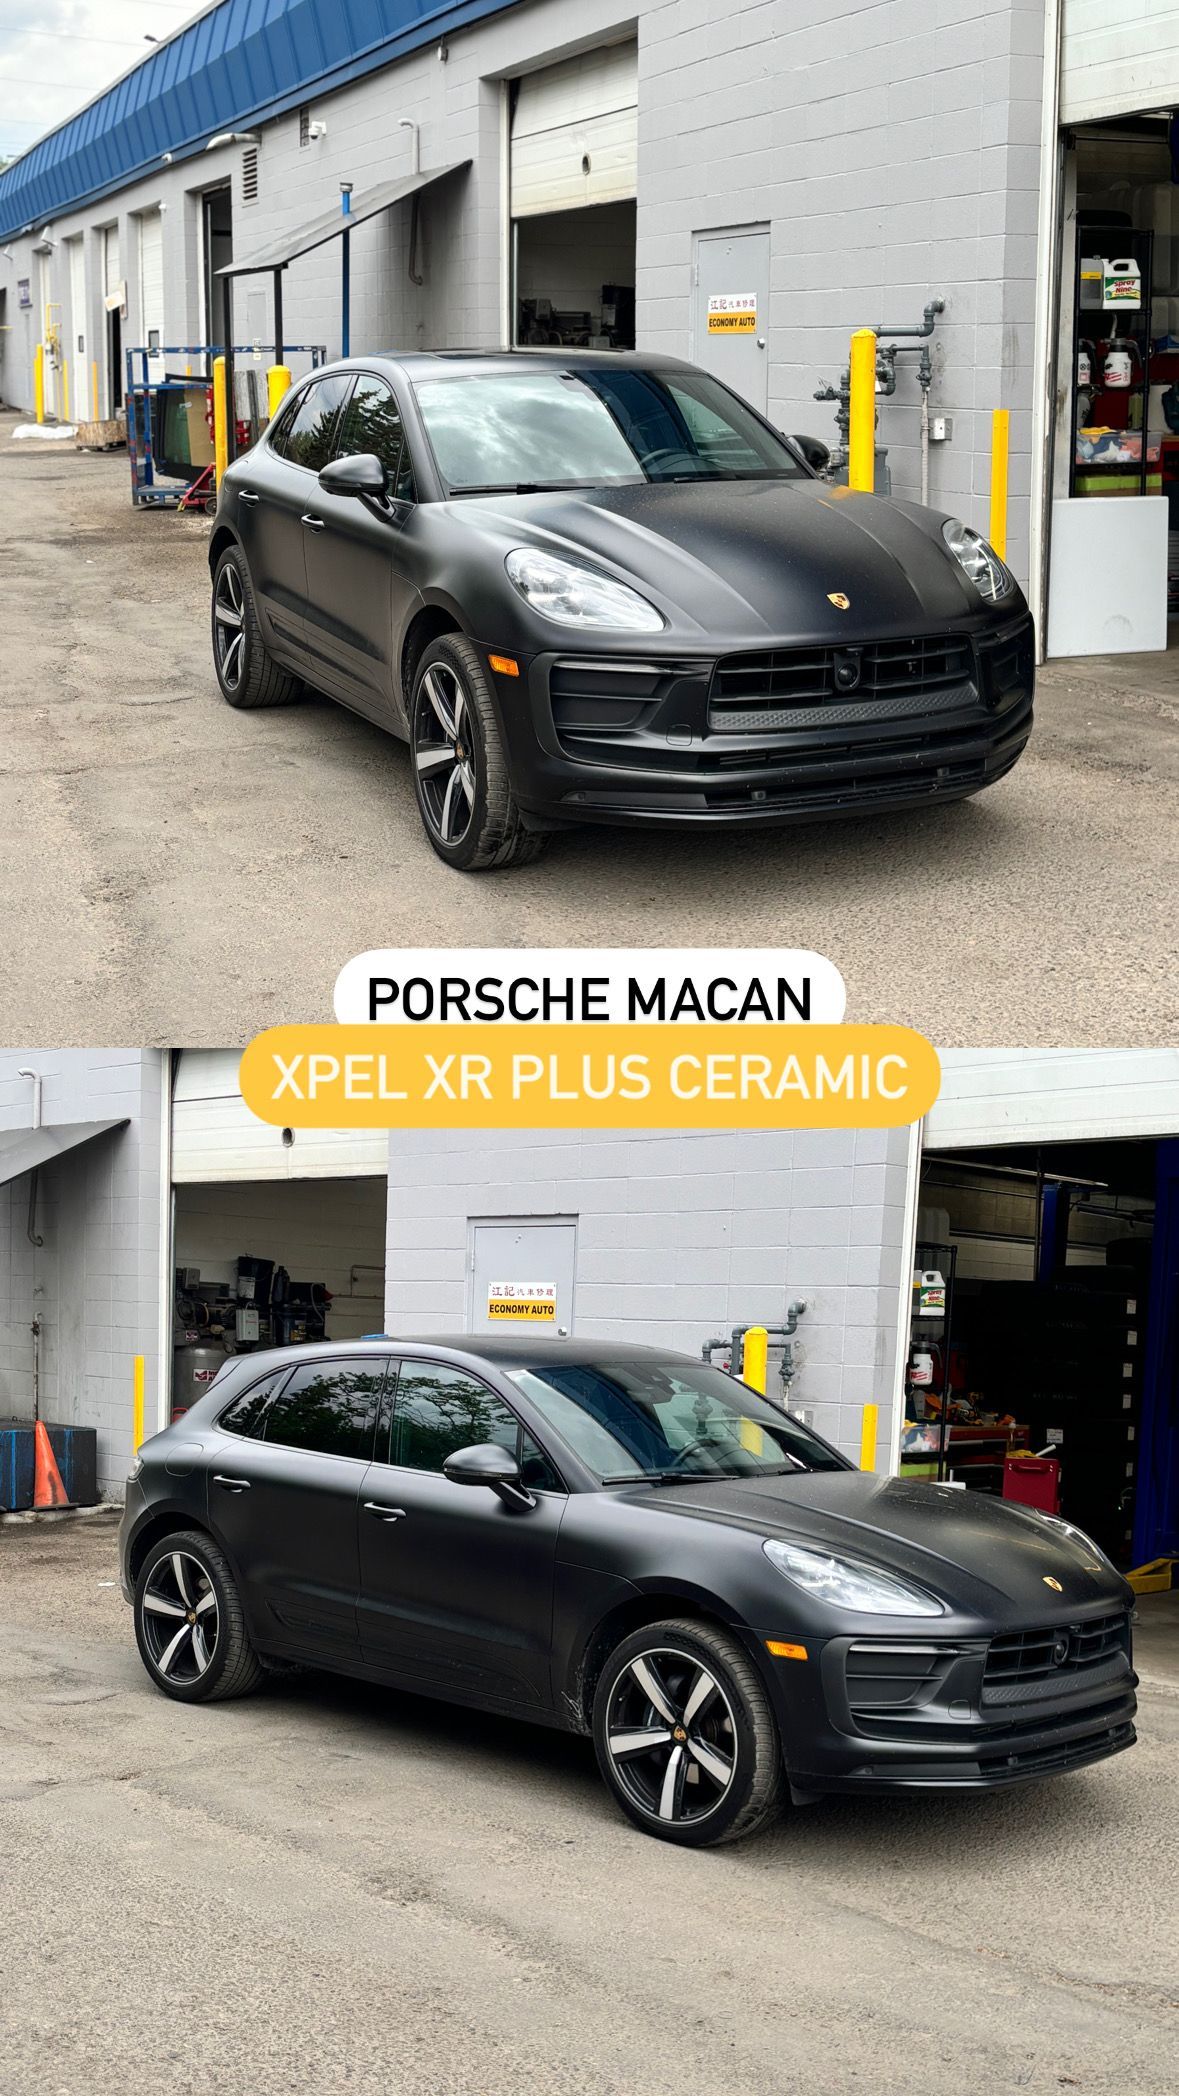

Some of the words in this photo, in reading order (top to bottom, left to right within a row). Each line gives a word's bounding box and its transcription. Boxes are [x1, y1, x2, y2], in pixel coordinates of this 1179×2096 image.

[1114, 279, 1136, 288] Spray
[709, 318, 738, 327] ECONOMY
[739, 317, 755, 326] AUTO
[489, 1304, 530, 1314] ECONOMY
[531, 1306, 554, 1314] AUTO
